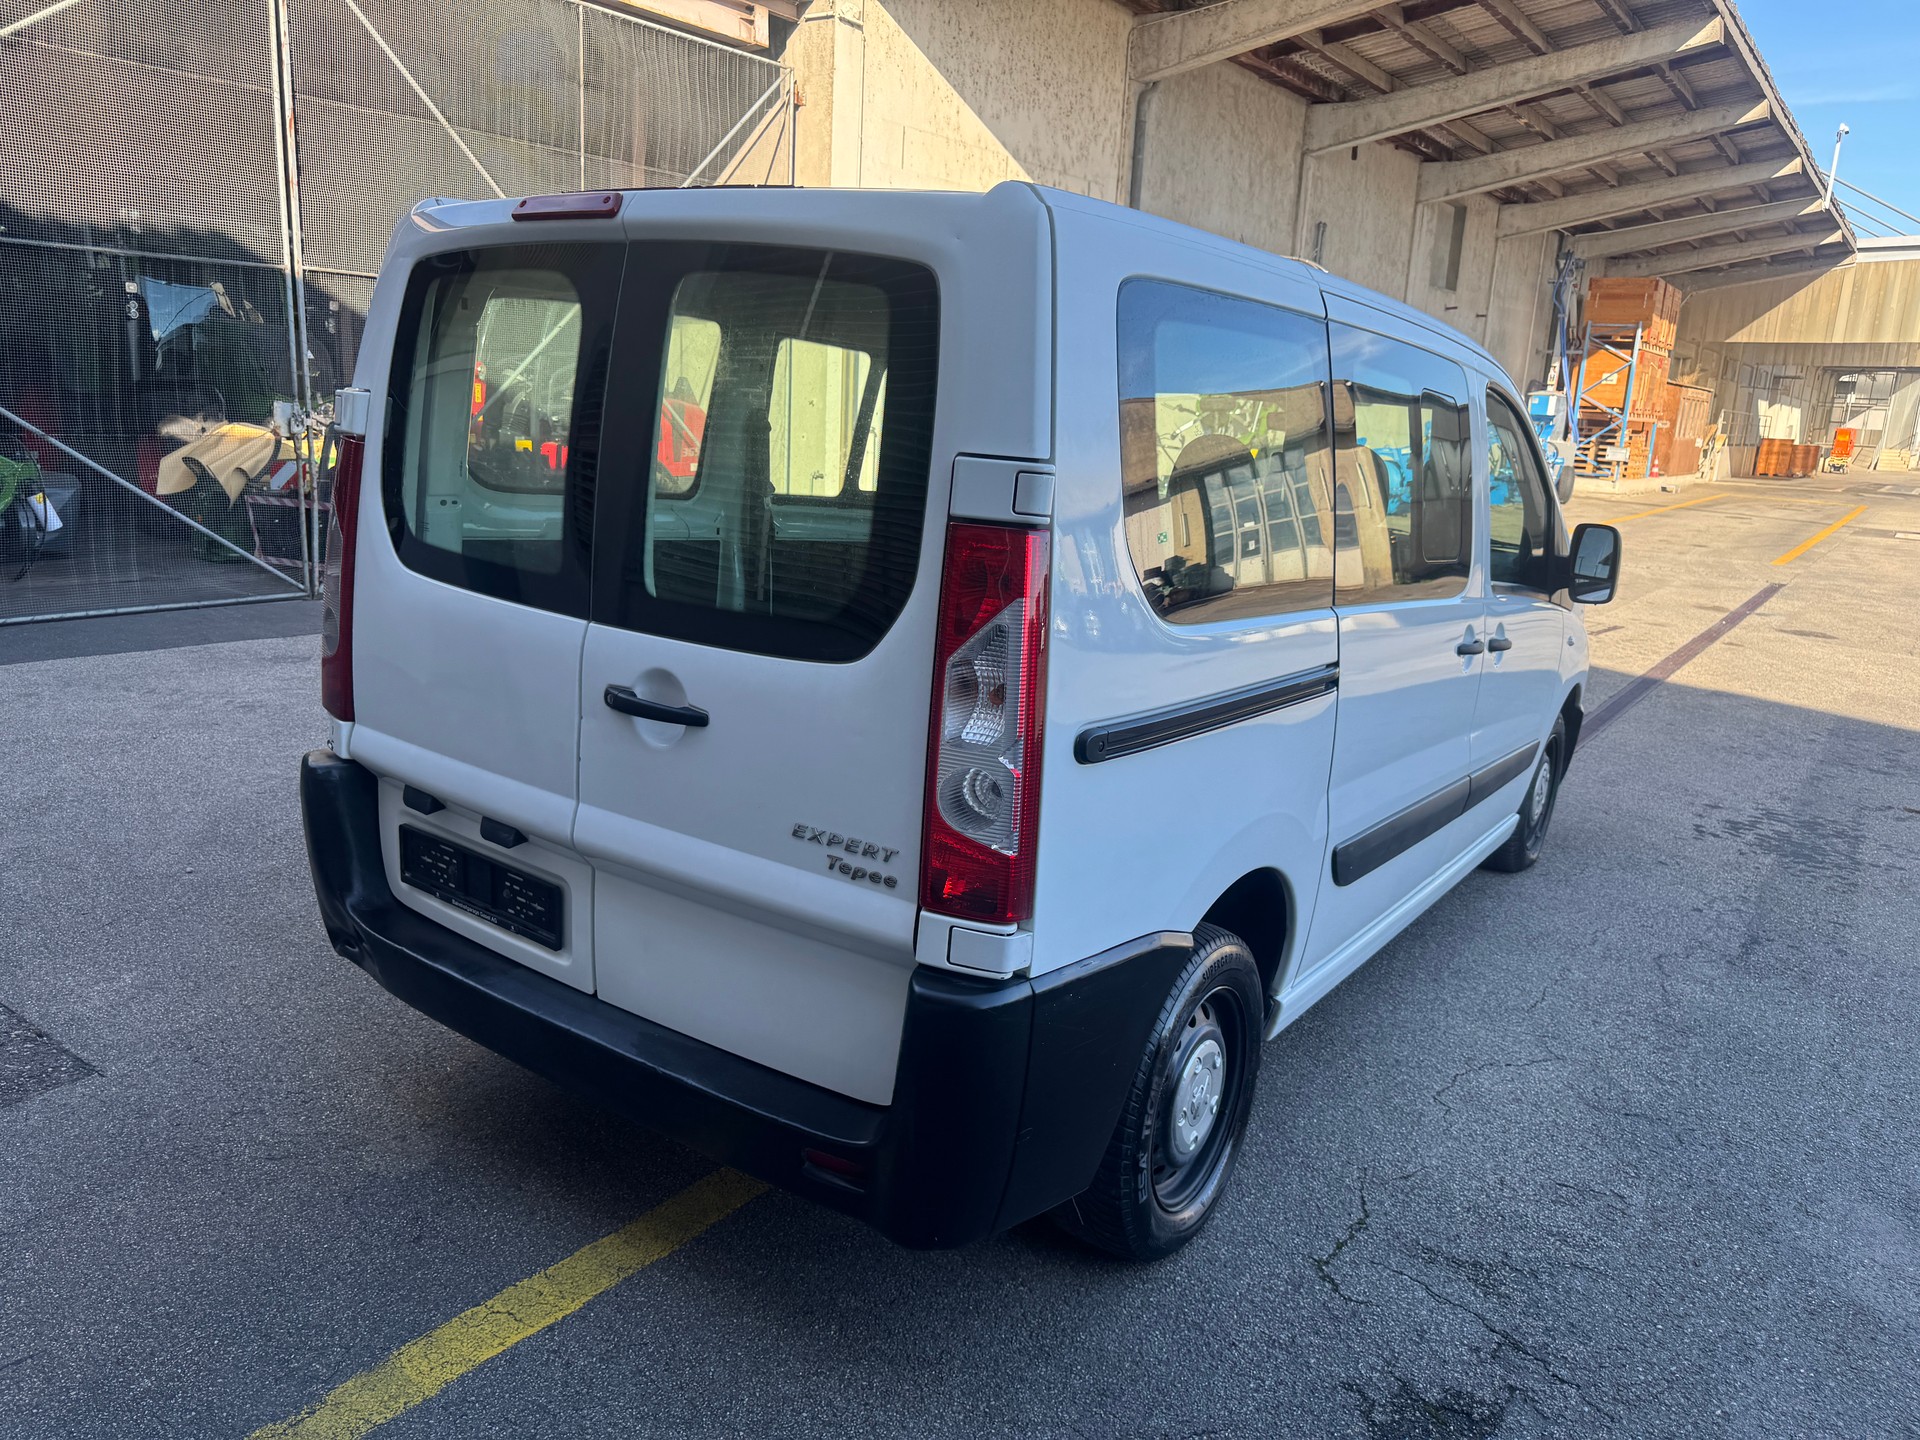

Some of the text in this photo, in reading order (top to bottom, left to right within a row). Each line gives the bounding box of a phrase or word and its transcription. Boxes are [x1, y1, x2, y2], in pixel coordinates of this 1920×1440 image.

[792, 823, 900, 862] EXPERT
[826, 854, 898, 888] Tepee
[1202, 953, 1234, 982] SUPERGRIP
